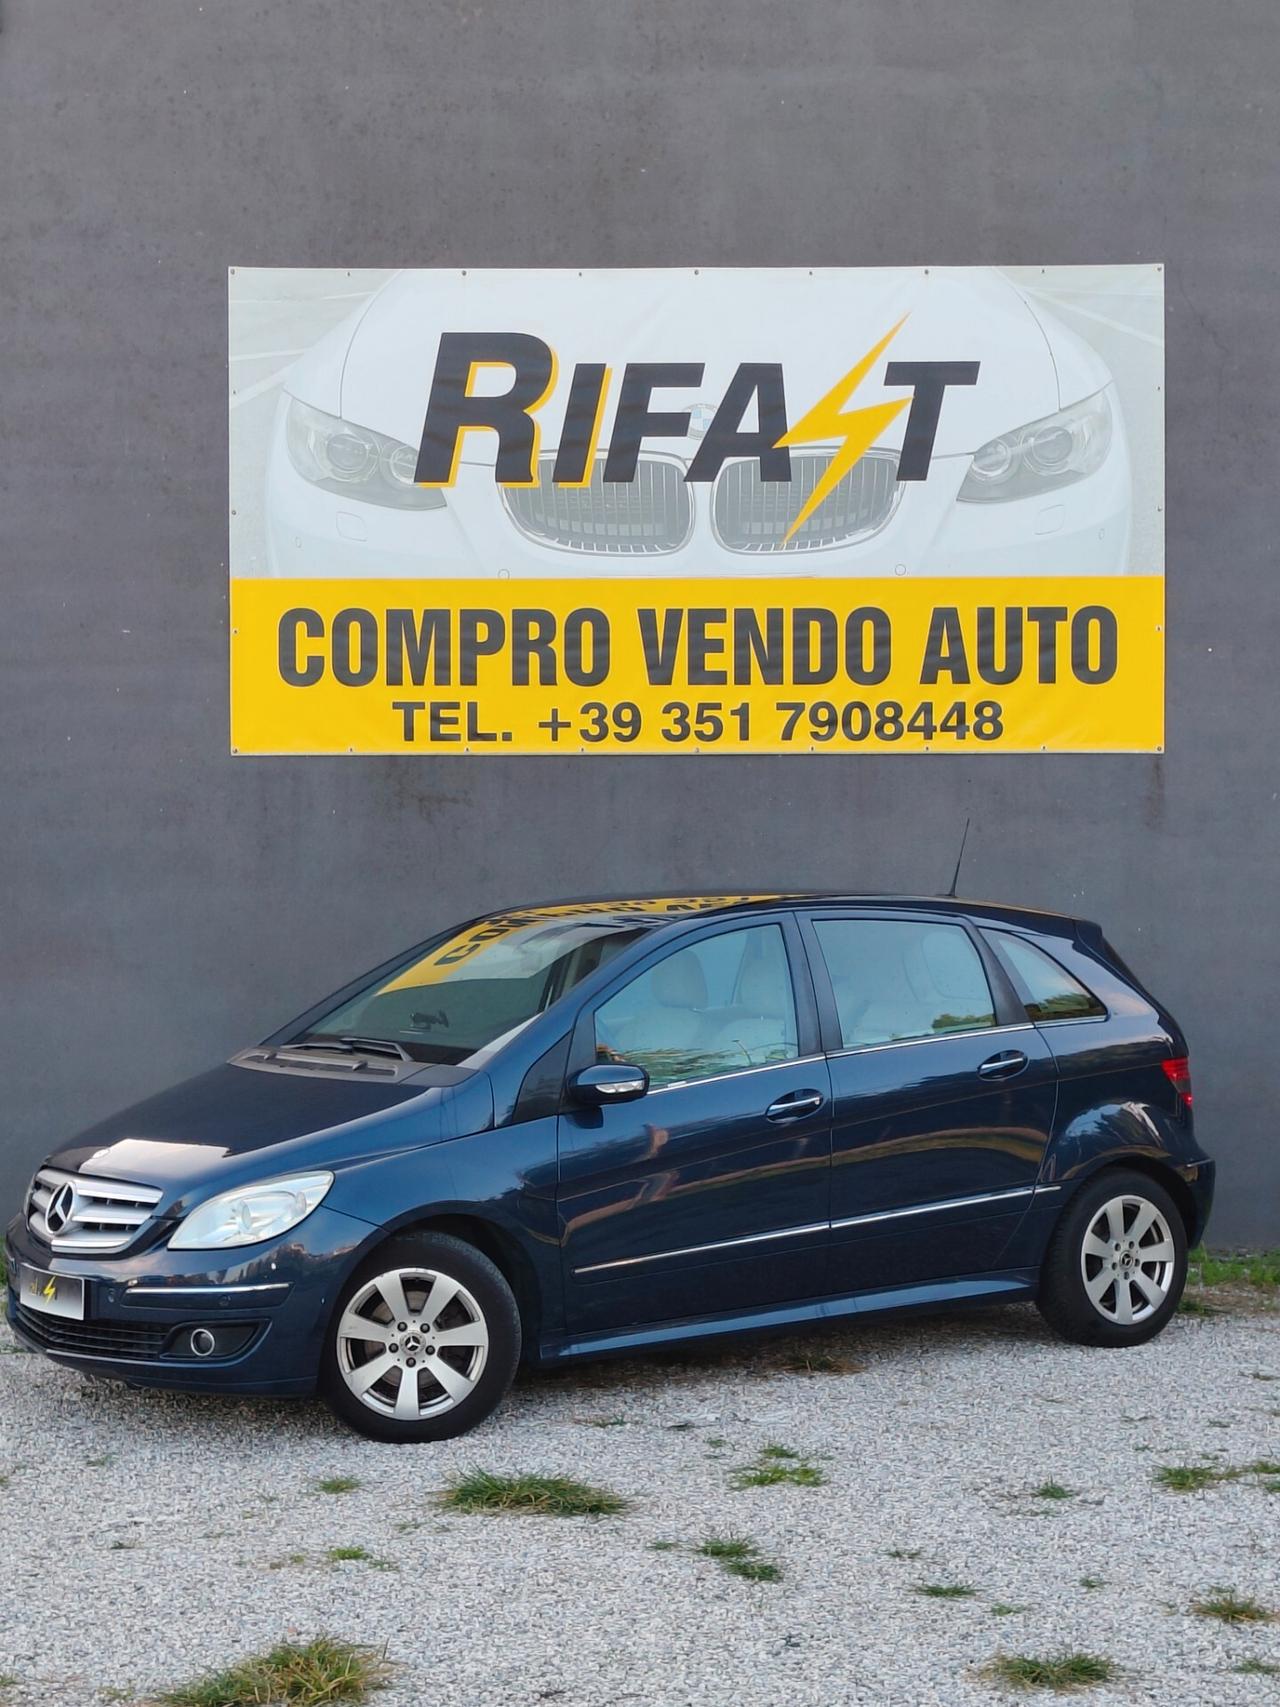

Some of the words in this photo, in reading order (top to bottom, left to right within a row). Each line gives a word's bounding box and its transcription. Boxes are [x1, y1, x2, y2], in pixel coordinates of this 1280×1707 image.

[279, 608, 610, 687] COMPRO
[637, 607, 891, 687] VENDO
[920, 605, 1118, 685] AUTO
[392, 701, 512, 741] TEL.
[539, 702, 642, 741] +39
[662, 702, 752, 741] 351
[776, 700, 1004, 741] 7908448
